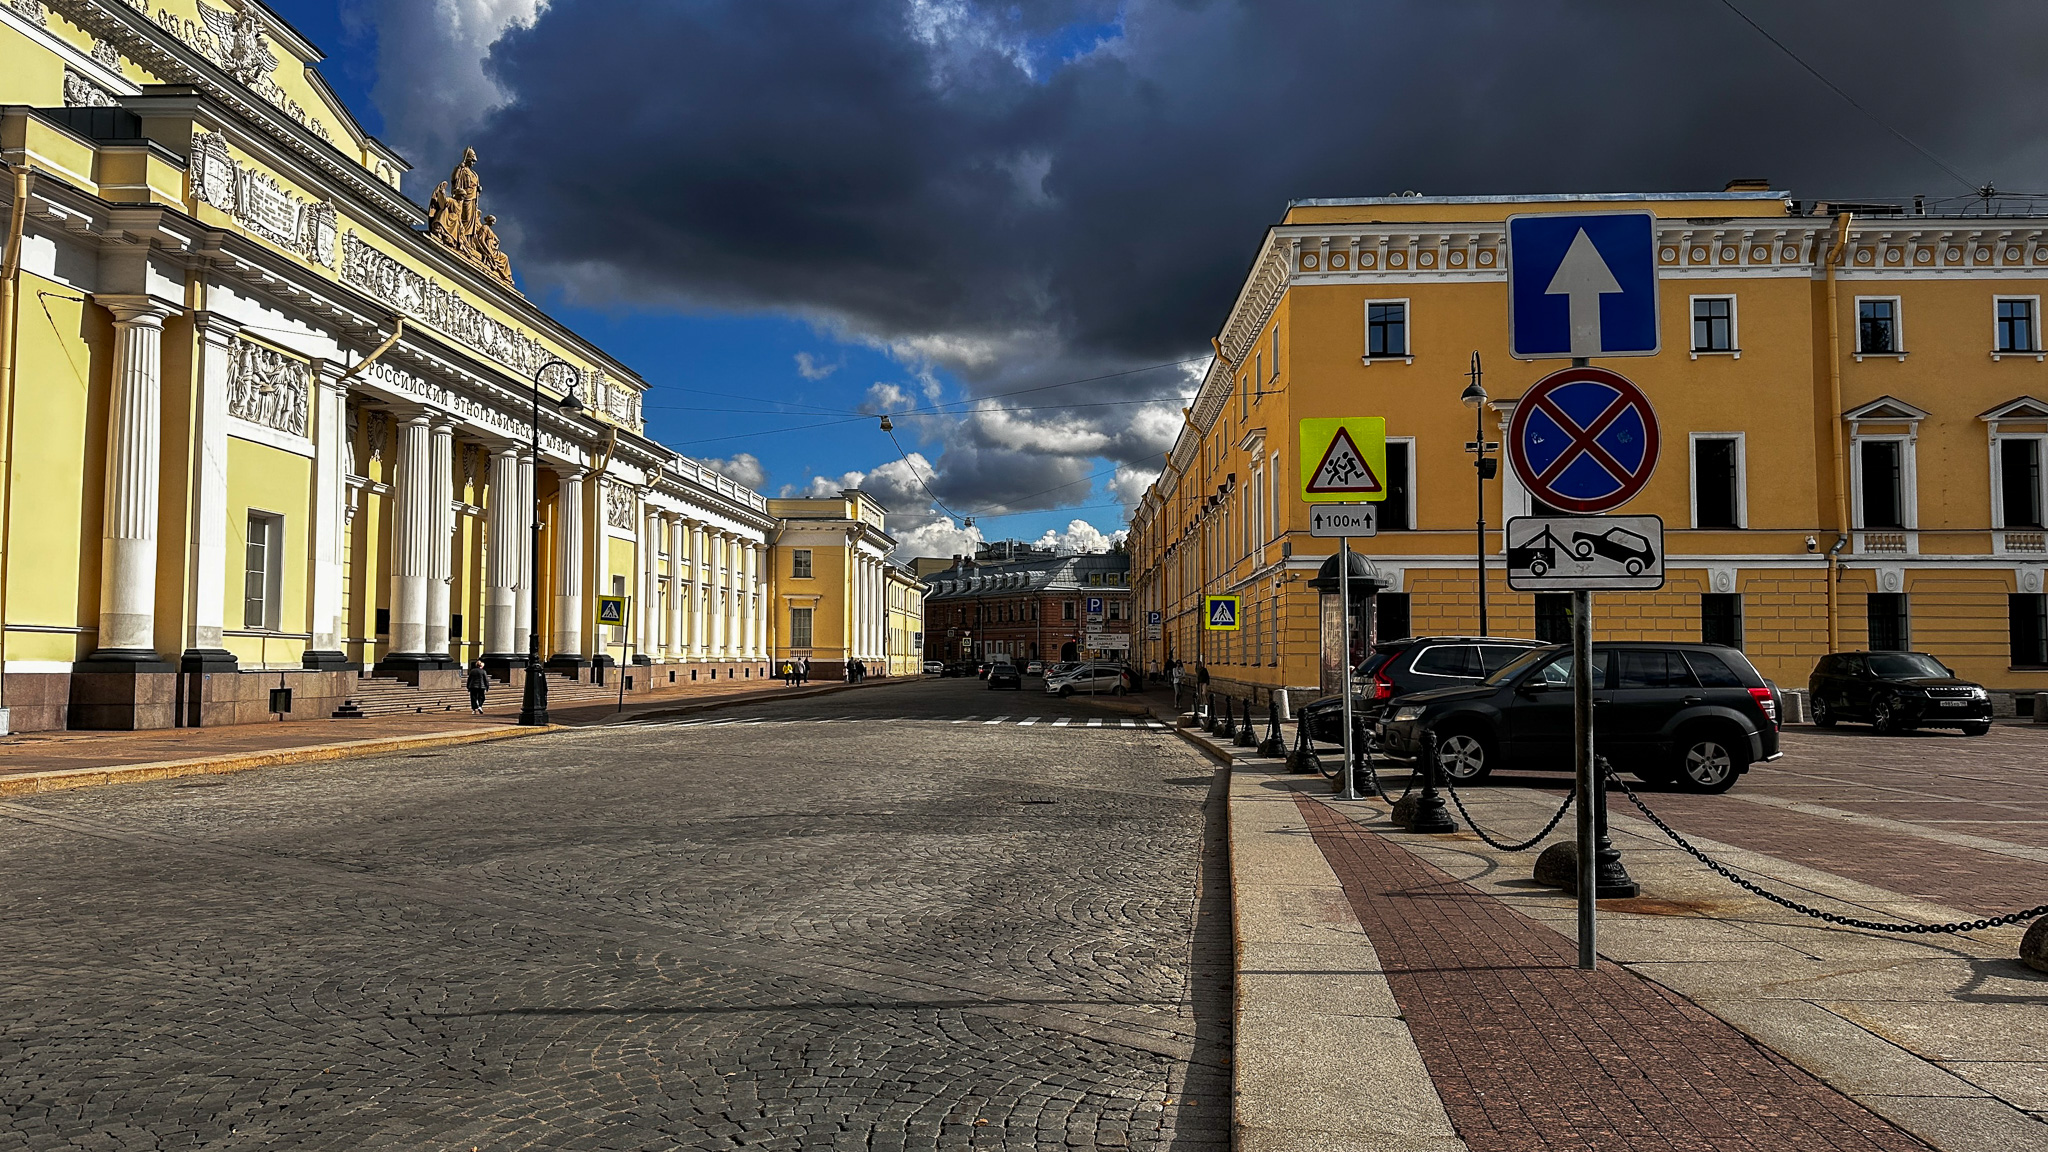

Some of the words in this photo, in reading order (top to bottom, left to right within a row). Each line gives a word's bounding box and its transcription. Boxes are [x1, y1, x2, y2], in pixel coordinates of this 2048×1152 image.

[369, 361, 448, 406] РОССИЙСКИЙ
[454, 398, 542, 444] ЭТНОГРАФИЧЕСКЙ
[547, 435, 571, 456] МУЗЕЙ
